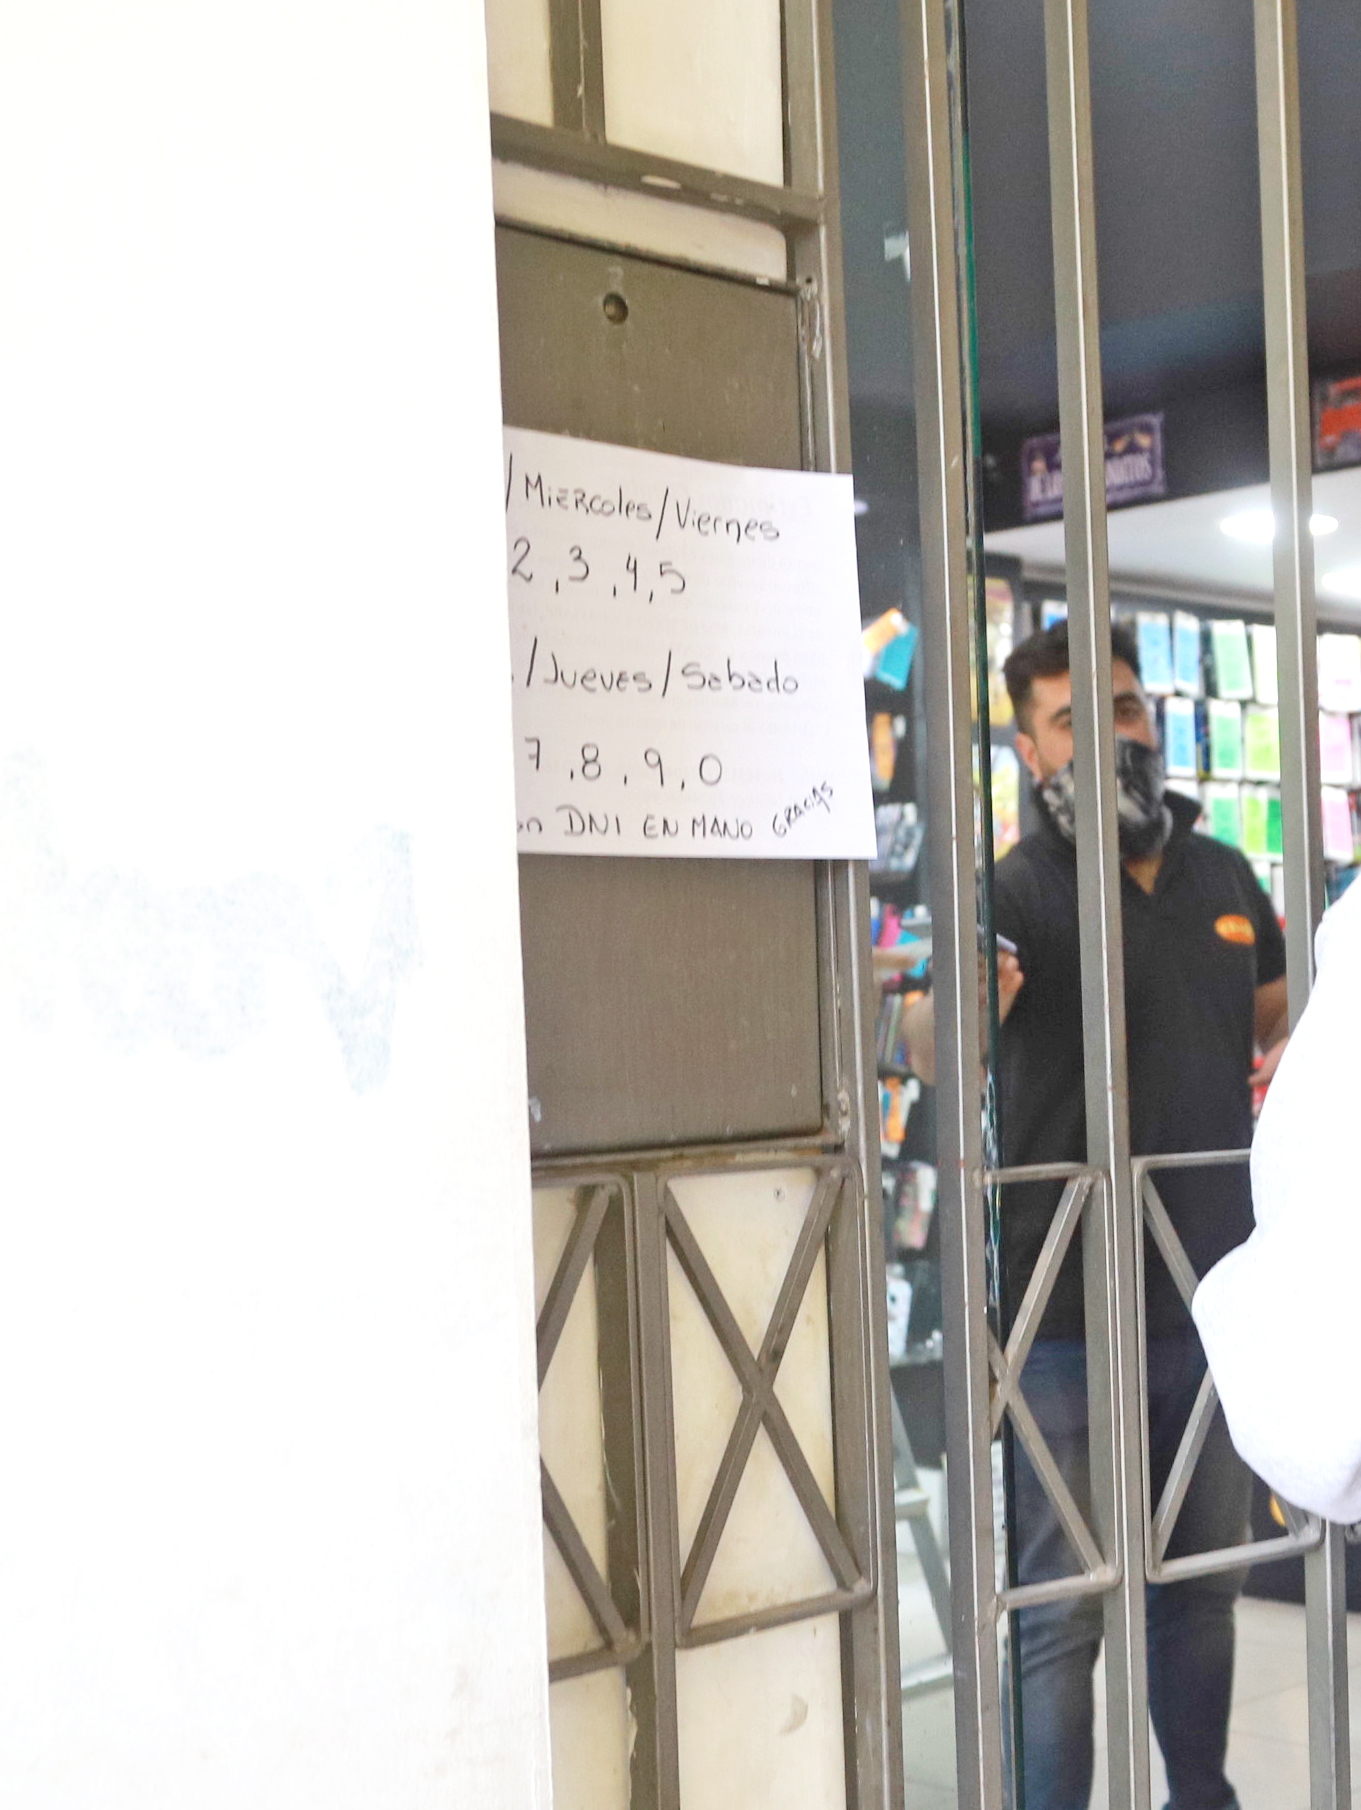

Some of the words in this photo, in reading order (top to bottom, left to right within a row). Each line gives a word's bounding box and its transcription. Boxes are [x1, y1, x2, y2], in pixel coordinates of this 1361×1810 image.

[555, 803, 622, 837] DNI
[642, 812, 679, 839] EN
[691, 812, 753, 841] MANO
